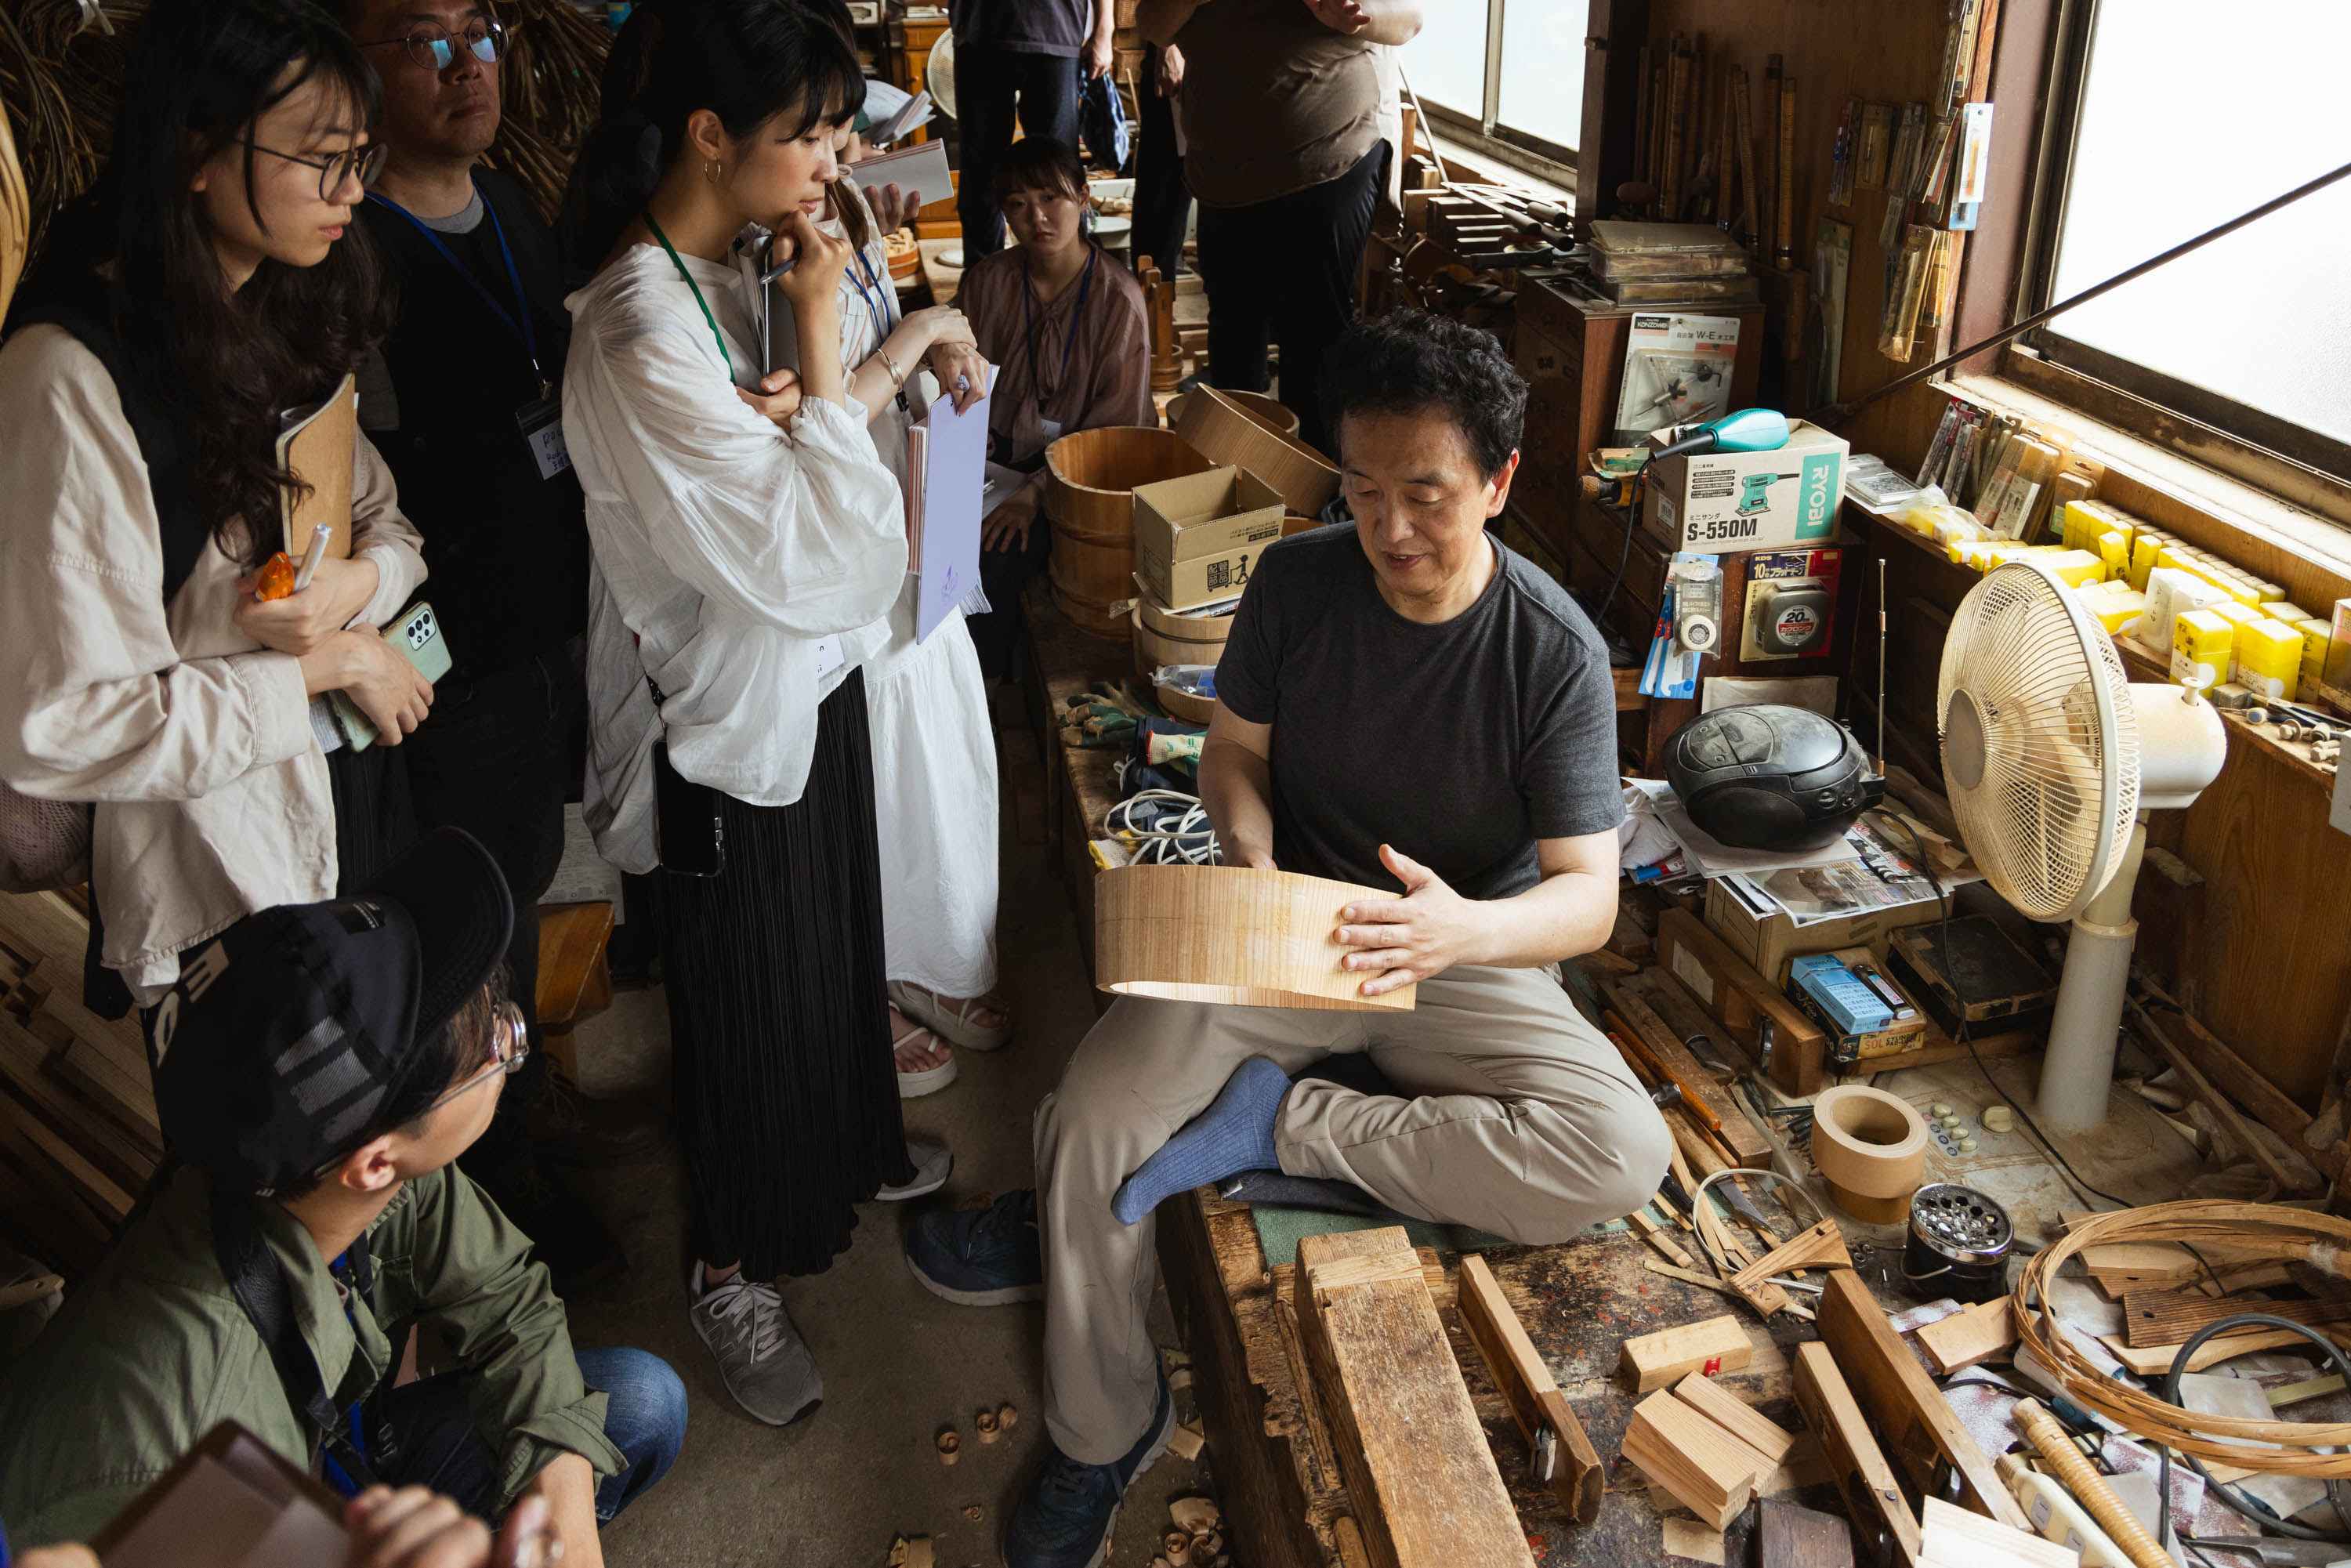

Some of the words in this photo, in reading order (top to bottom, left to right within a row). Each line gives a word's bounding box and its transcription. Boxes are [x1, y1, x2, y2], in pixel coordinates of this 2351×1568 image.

[1806, 464, 1830, 527] RYOBI
[1689, 512, 1721, 521] ミニサンダ
[1686, 518, 1758, 541] S-550M
